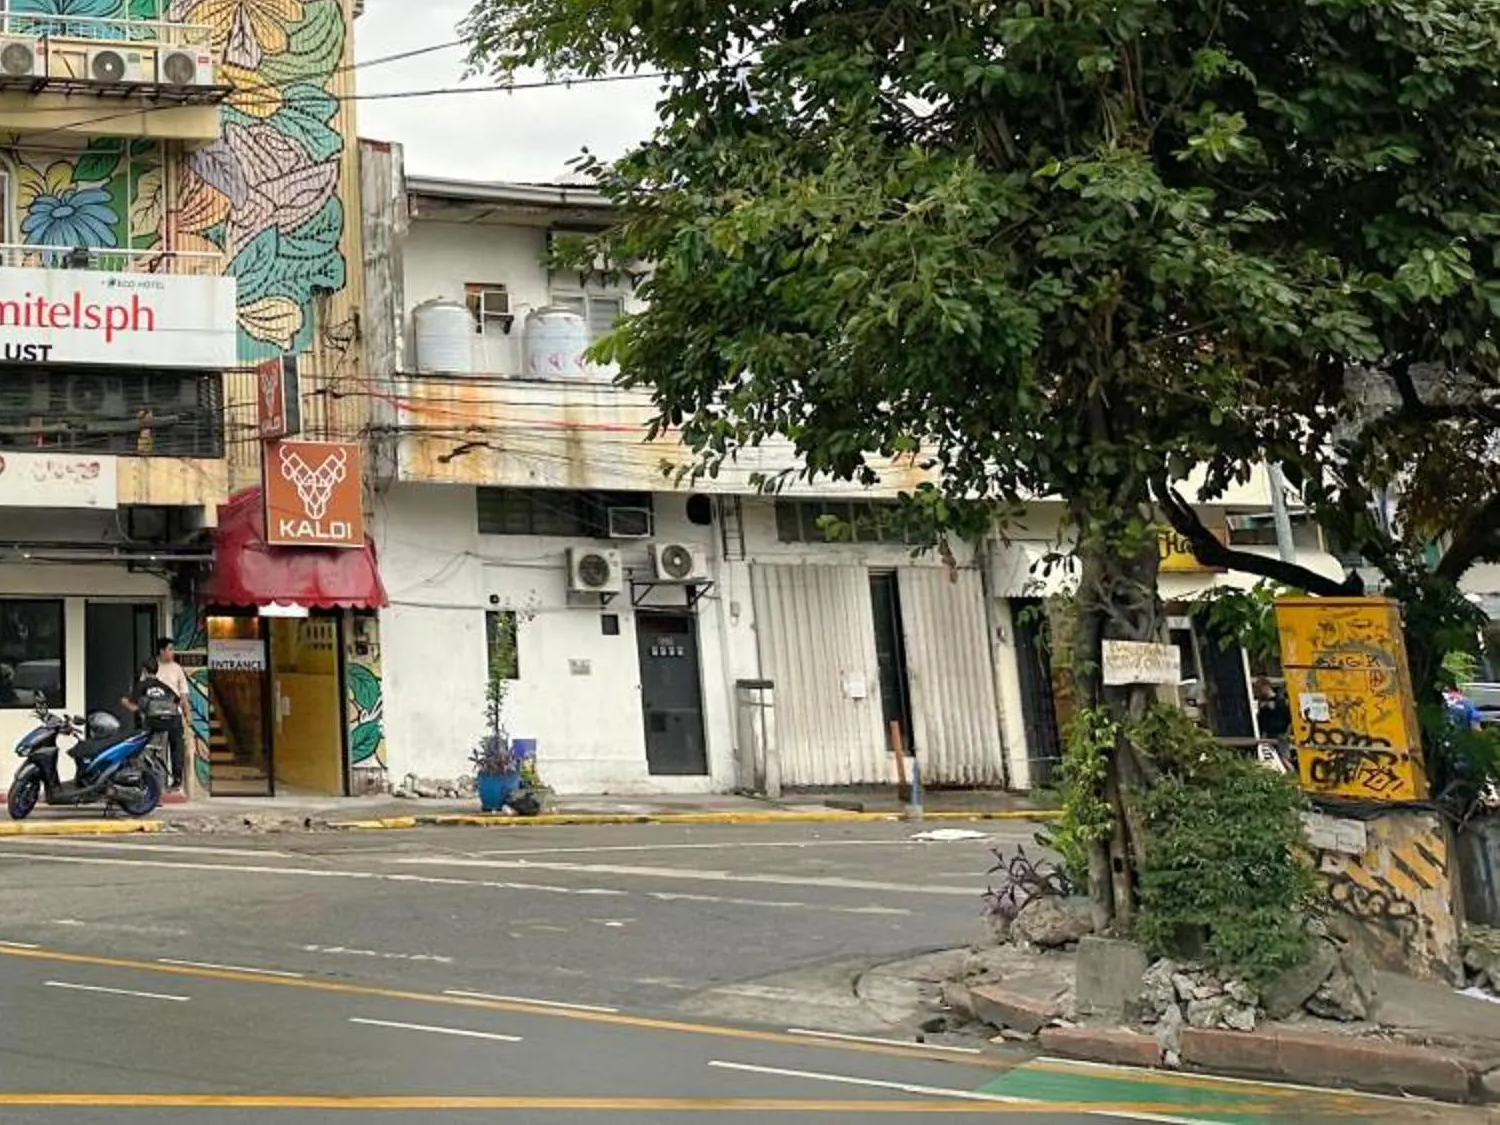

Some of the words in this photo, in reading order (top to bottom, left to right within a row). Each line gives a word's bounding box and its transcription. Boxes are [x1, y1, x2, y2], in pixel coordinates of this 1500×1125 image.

[4, 342, 52, 362] UST
[280, 518, 352, 540] KALDI
[211, 660, 262, 671] ENTRANCE
